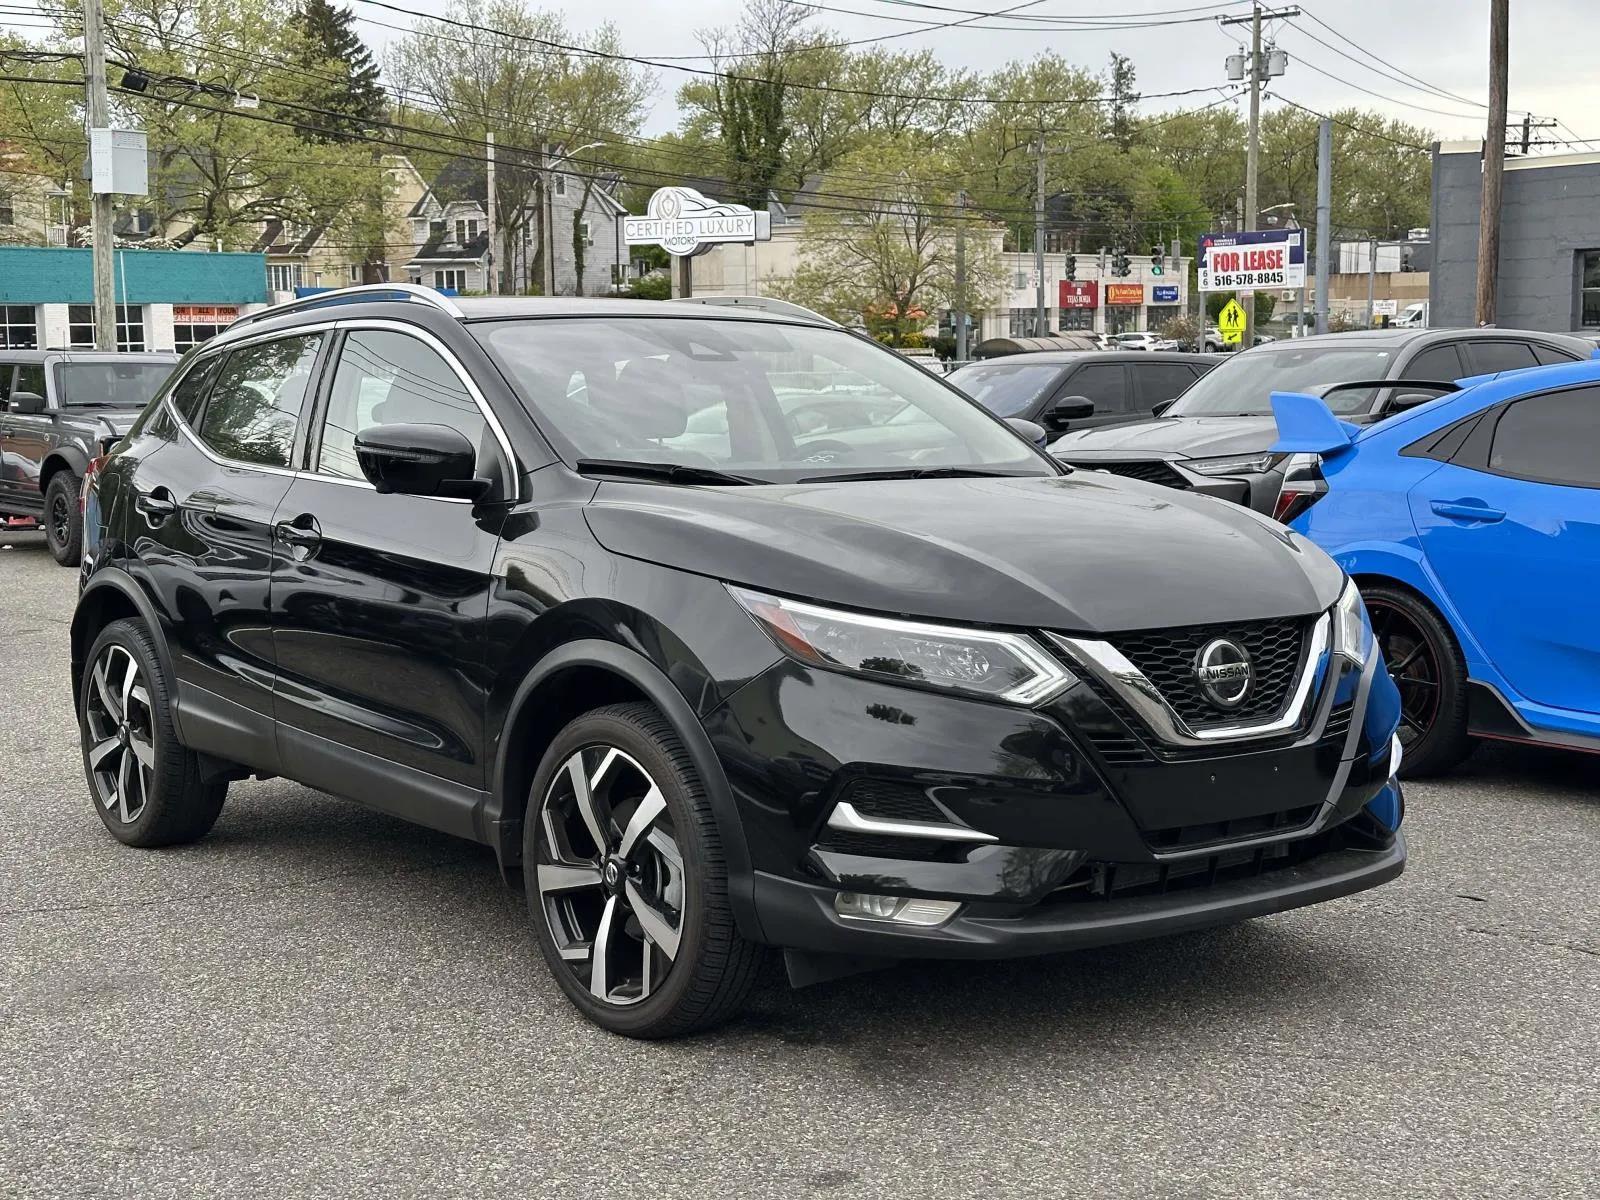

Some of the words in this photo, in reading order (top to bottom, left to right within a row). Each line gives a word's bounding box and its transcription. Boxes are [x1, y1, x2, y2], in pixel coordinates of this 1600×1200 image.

[625, 221, 694, 237] CERTIFIED
[700, 218, 753, 234] LUXURY
[664, 236, 696, 246] MOTORS
[1213, 252, 1240, 273] FOR
[1243, 249, 1284, 271] LEASE
[1214, 272, 1283, 286] 516-578-8845
[1206, 666, 1248, 679] NISSAN
